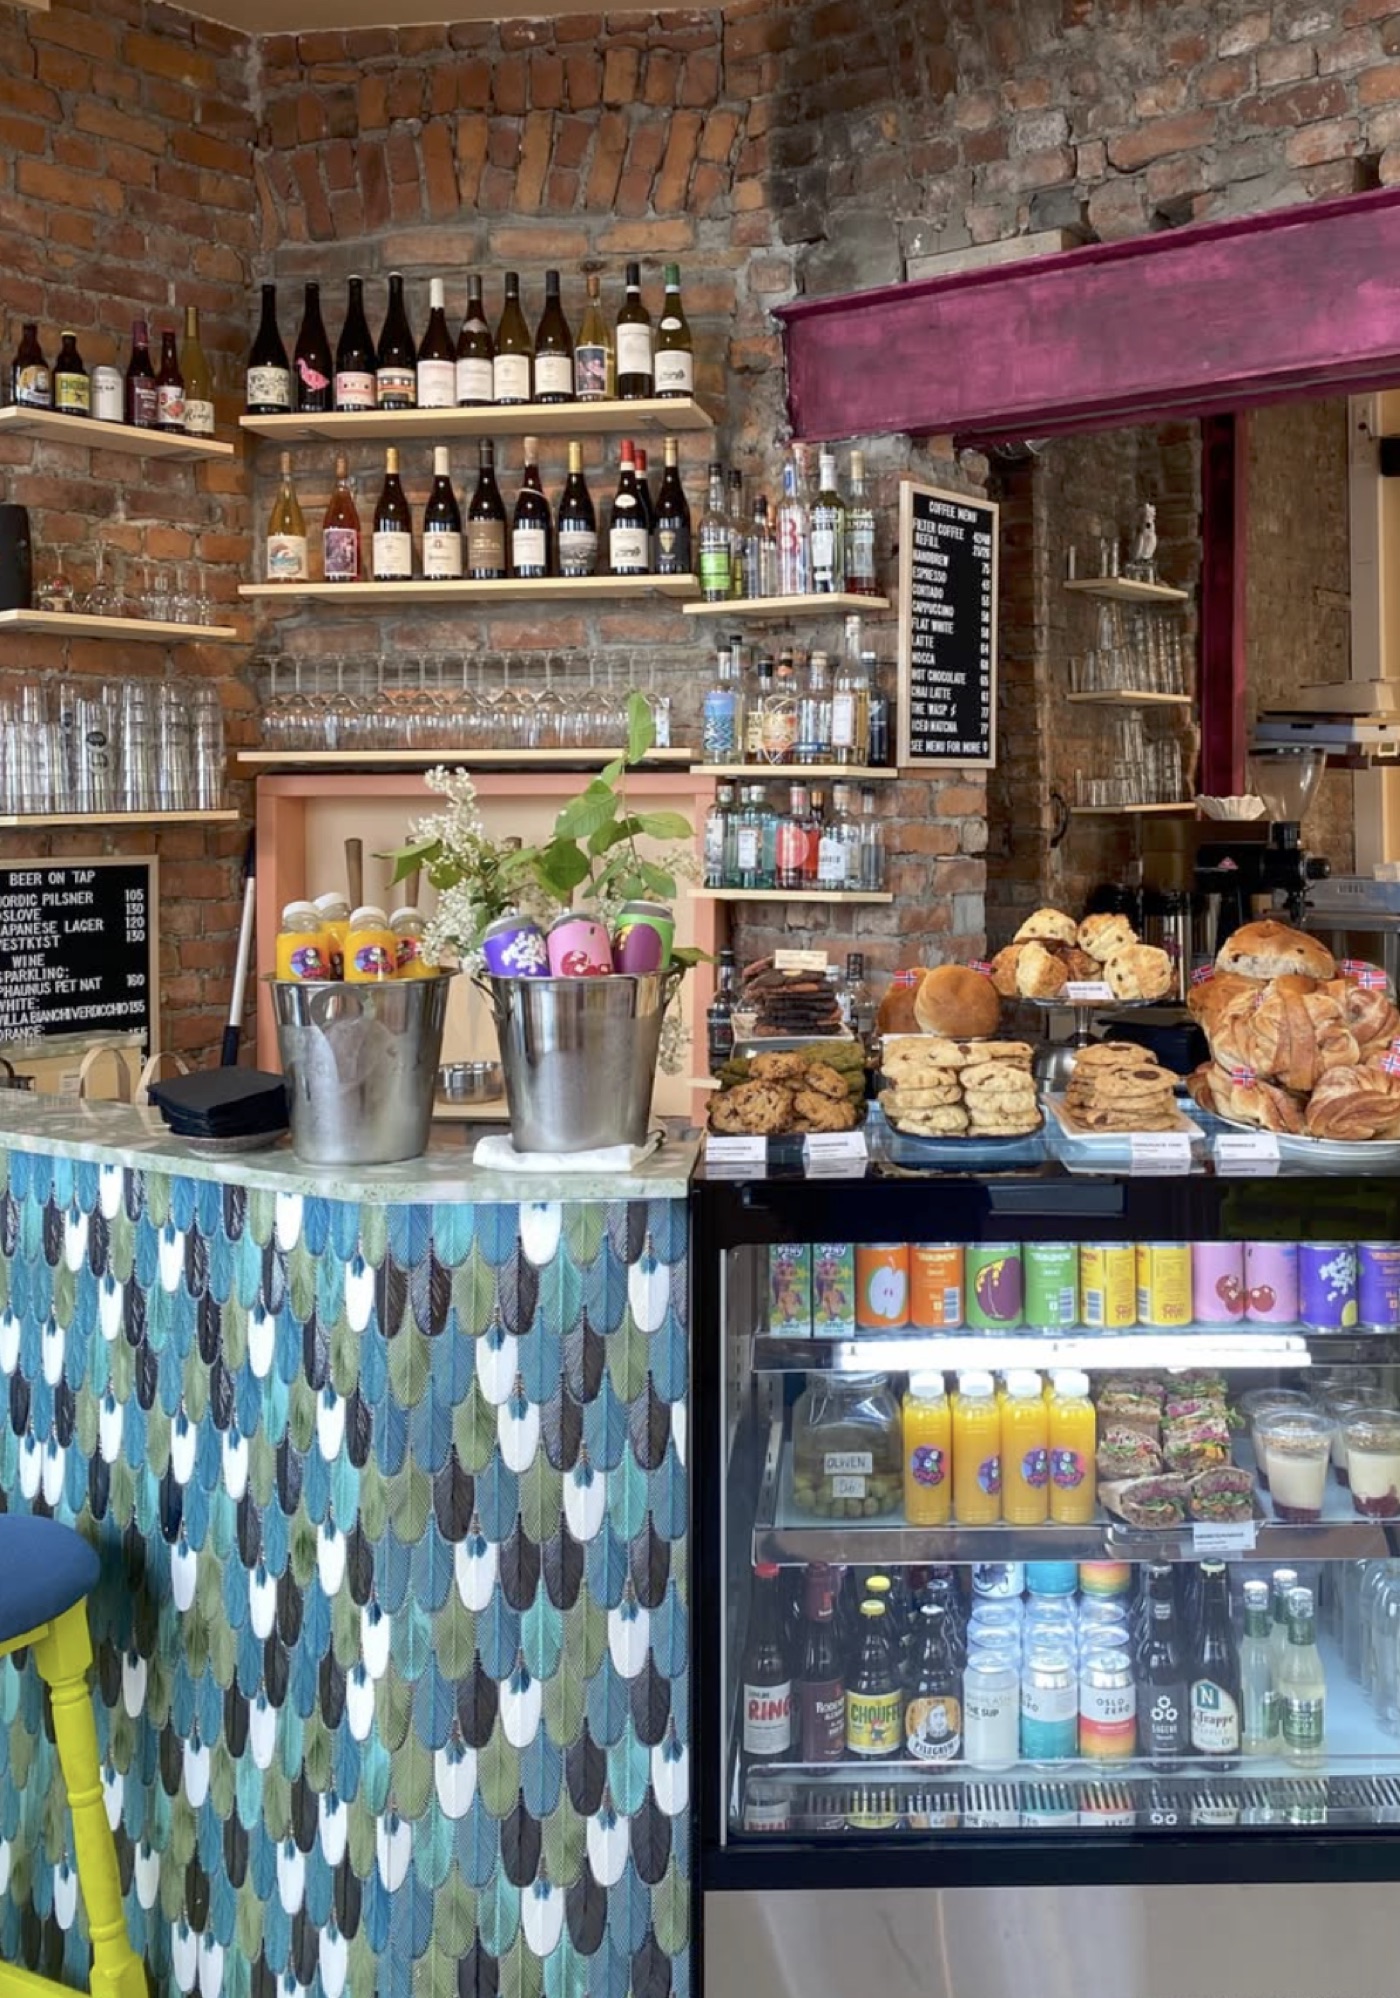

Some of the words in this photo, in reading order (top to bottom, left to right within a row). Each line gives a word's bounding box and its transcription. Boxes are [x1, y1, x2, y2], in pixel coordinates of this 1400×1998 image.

[10, 872, 42, 886] BEER
[48, 871, 65, 885] ON
[72, 870, 96, 884] TAP
[0, 893, 38, 908] ORDIC
[42, 891, 94, 906] PILSNER
[124, 888, 145, 902] 105
[0, 908, 42, 922] SLOVE
[124, 915, 145, 929] 120
[0, 920, 58, 937] APANESE
[12, 953, 46, 968] WINE
[55, 979, 78, 993] PET
[80, 977, 102, 991] NAT
[1200, 1685, 1215, 1706] N
